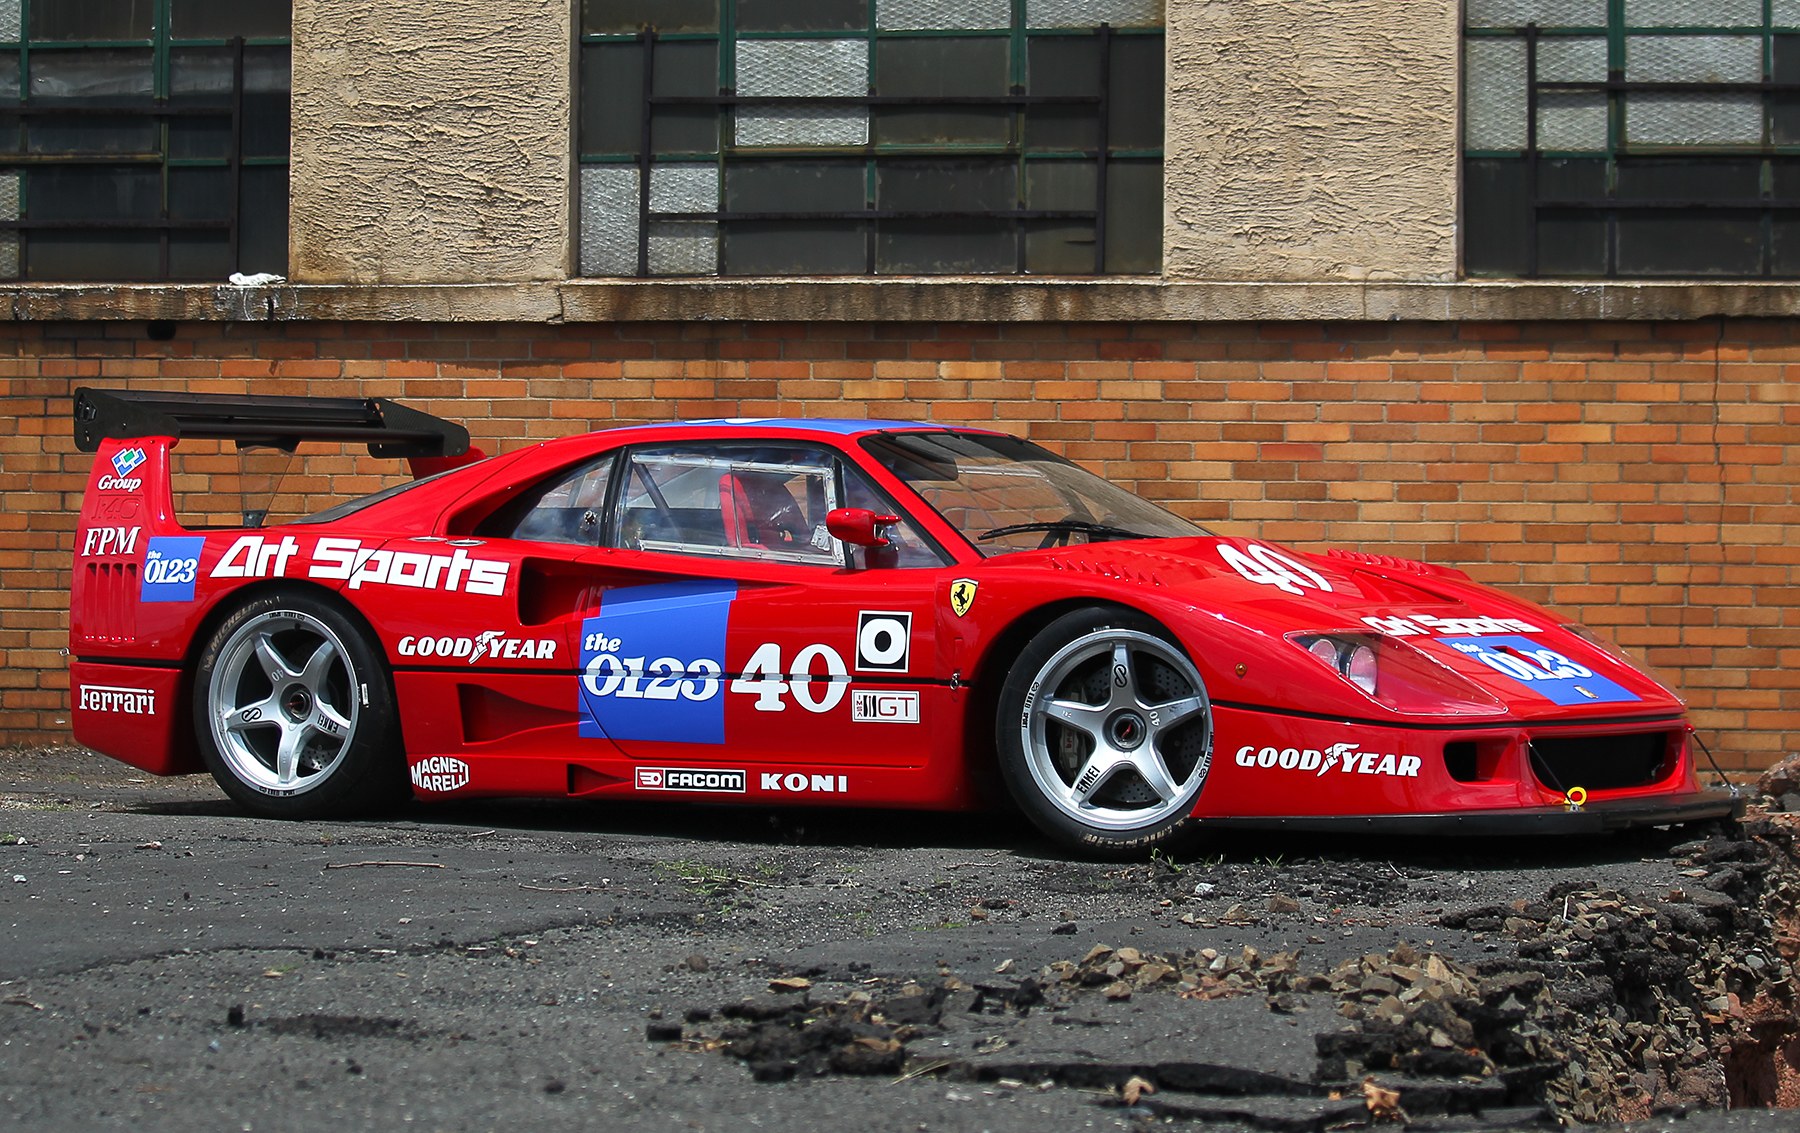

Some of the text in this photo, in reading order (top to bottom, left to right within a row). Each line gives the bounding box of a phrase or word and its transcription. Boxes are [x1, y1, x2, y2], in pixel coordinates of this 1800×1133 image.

[97, 474, 142, 492] Group
[81, 526, 142, 557] FPM
[147, 549, 162, 561] the
[209, 536, 510, 596] Art Sports
[144, 558, 198, 584] 0123
[1216, 544, 1333, 597] 40
[1360, 614, 1543, 637] Art Sports
[584, 633, 621, 652] the
[1451, 642, 1484, 653] the
[582, 653, 722, 702] 0123
[730, 643, 852, 714] 40
[79, 684, 155, 715] Ferrari
[878, 696, 915, 717] GT
[411, 756, 469, 783] MAGNETI
[667, 772, 743, 789] FACOM
[760, 772, 848, 793] KONI
[1076, 765, 1101, 795] ENKEI
